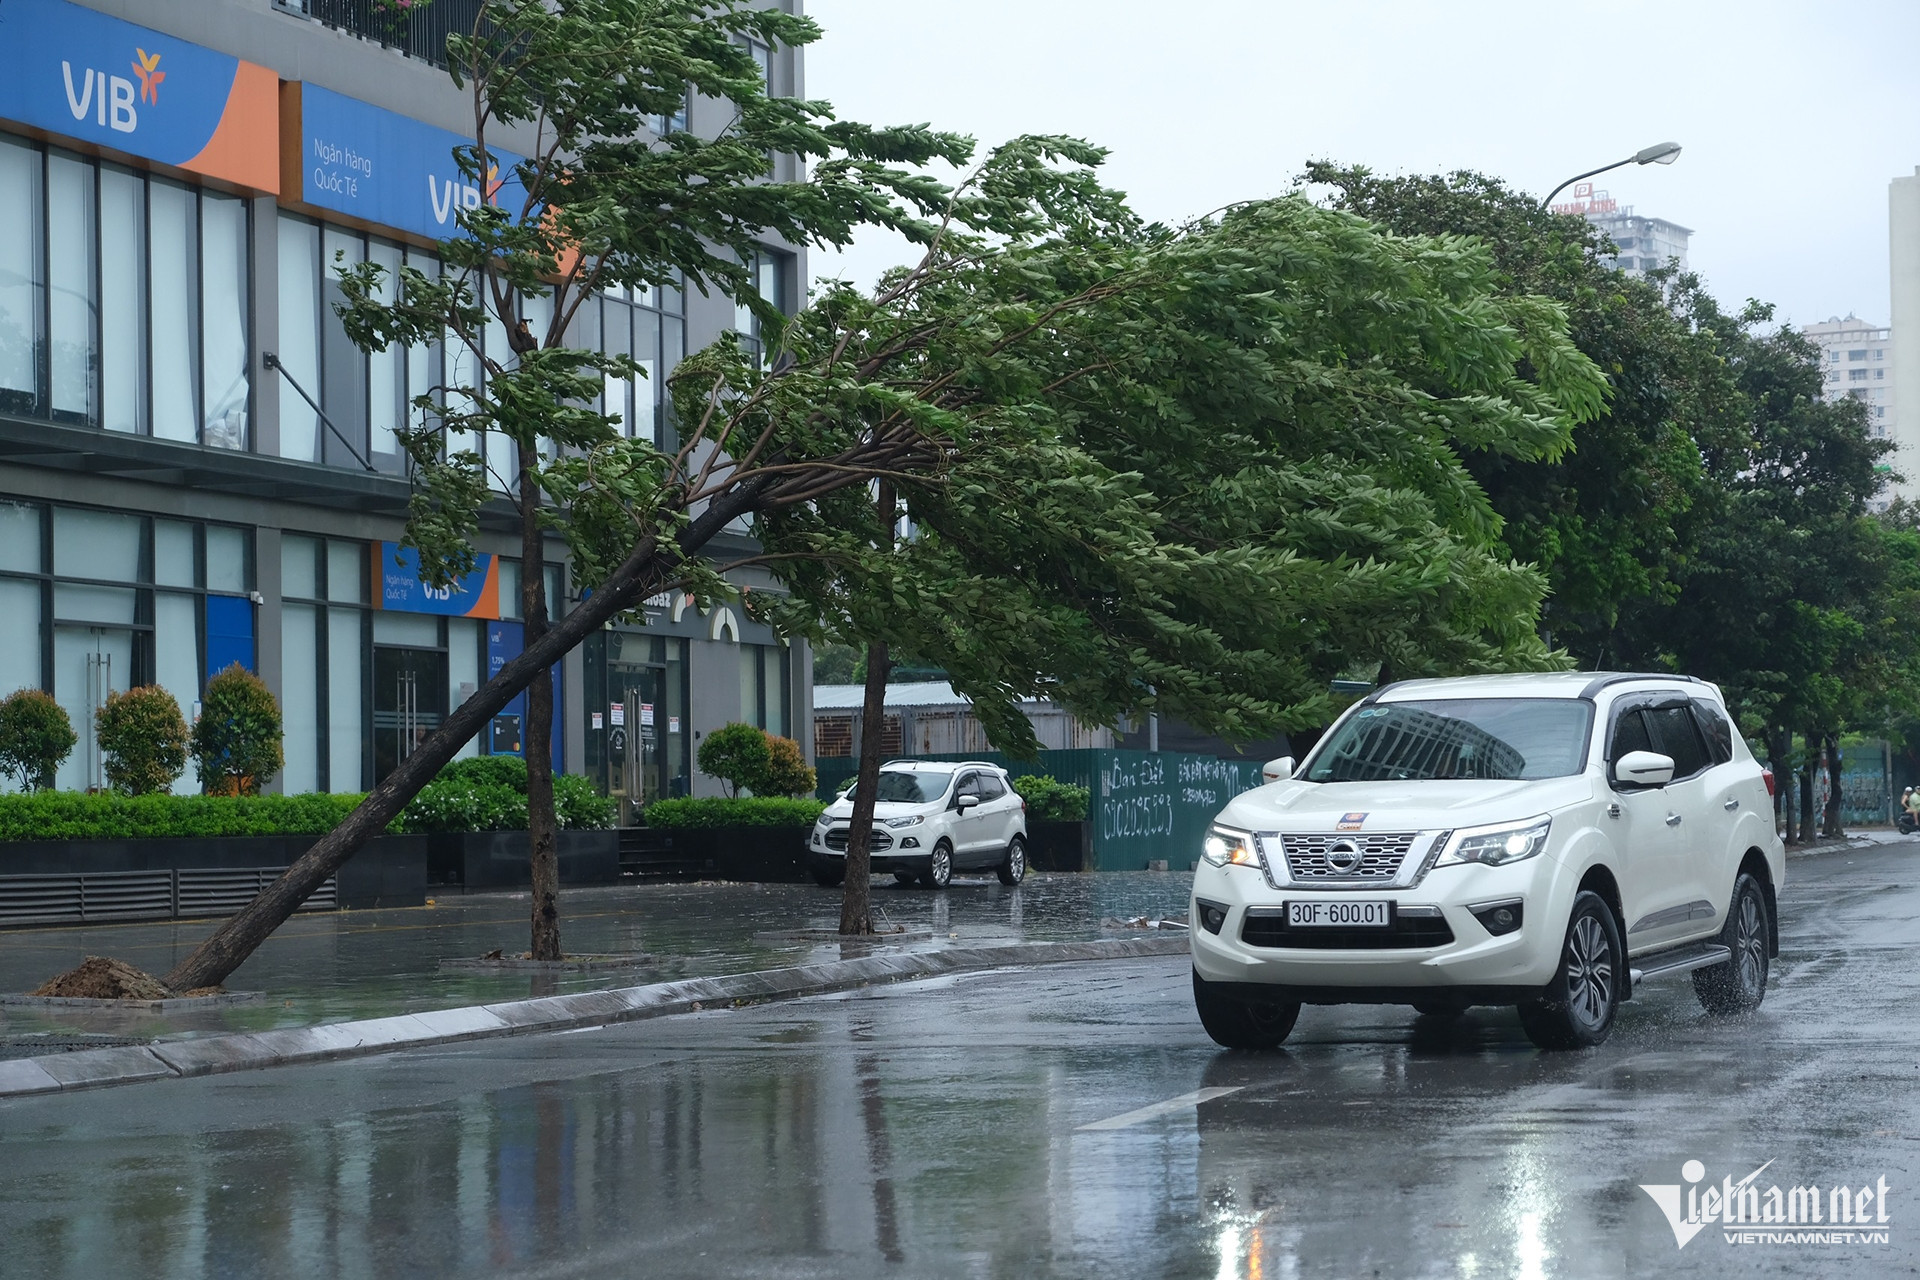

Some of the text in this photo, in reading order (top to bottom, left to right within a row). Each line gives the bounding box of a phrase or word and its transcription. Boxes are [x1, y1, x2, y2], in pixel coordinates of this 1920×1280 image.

[61, 60, 138, 134] VIB
[314, 138, 371, 178] Ngân hàng
[314, 167, 358, 198] Quốc Tế
[1291, 904, 1385, 923] 30F-600.01
